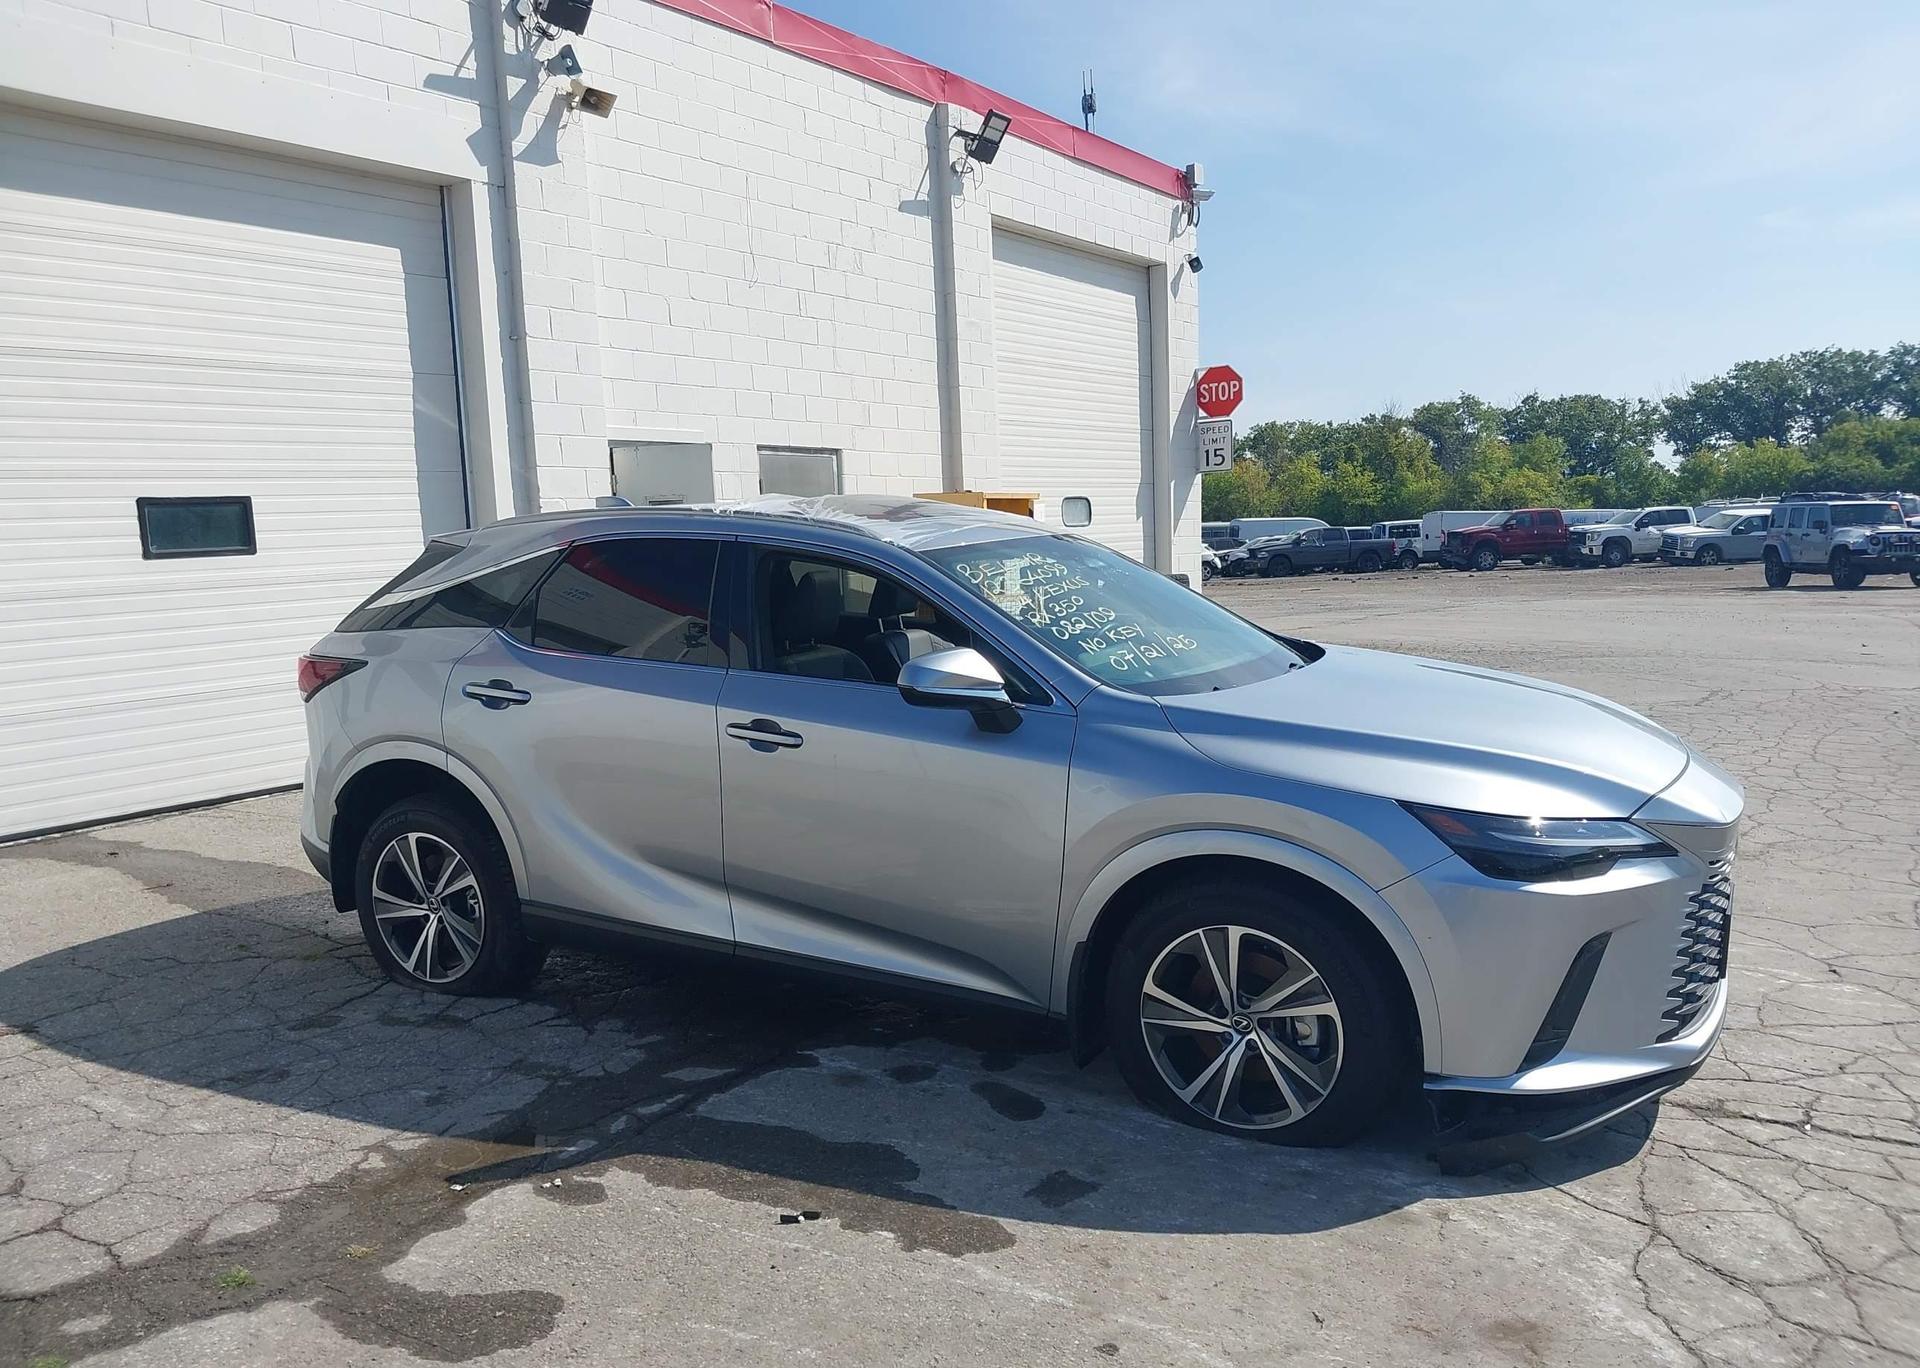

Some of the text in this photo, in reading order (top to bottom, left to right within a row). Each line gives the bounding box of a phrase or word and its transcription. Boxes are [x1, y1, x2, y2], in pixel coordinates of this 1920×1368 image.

[1200, 380, 1240, 403] STOP
[1200, 425, 1230, 435] SPEED
[1202, 436, 1227, 446] LIMIT
[1204, 448, 1226, 467] 15
[1032, 575, 1090, 601] LEXUS
[1025, 595, 1084, 628] RX 350
[1078, 622, 1146, 655] NO KEY
[1109, 632, 1198, 671] 07/21/25
